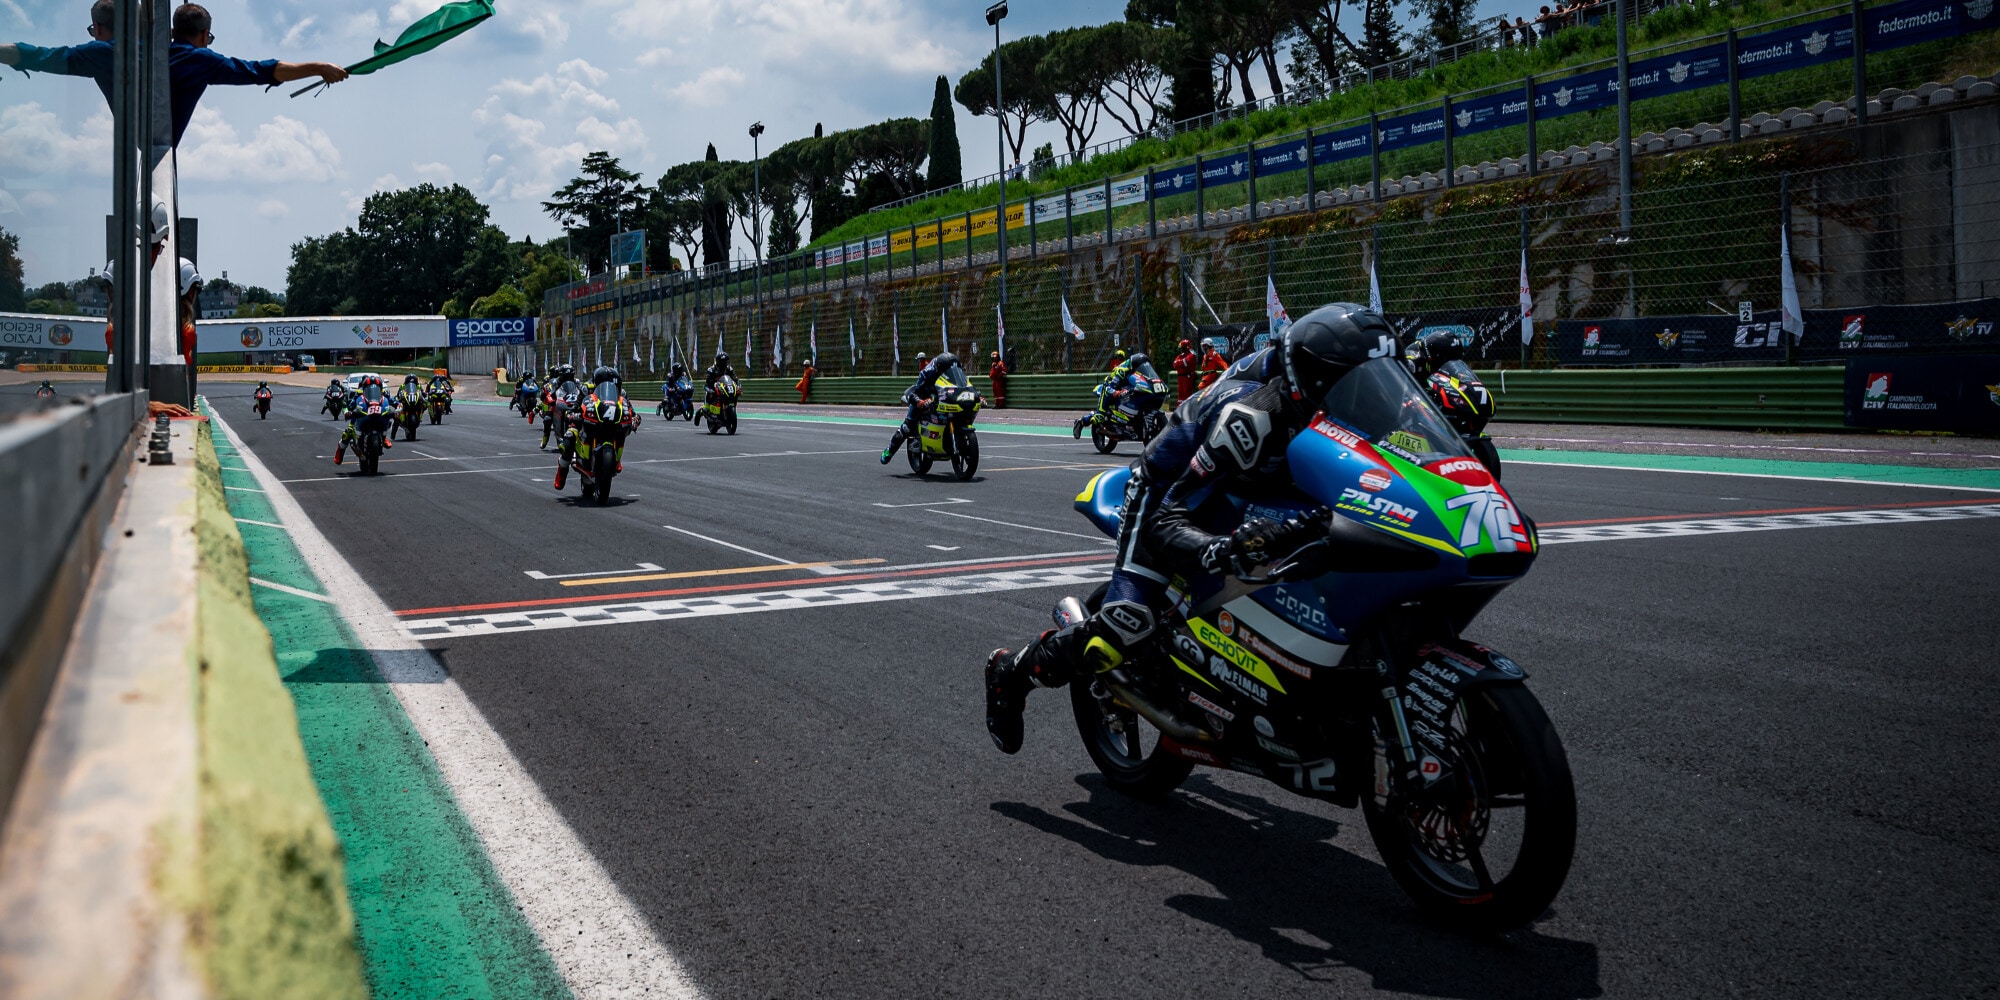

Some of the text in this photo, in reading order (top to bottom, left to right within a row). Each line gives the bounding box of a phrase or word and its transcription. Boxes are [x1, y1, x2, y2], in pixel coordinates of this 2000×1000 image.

[1878, 5, 1953, 34] federmoto.it
[1331, 135, 1367, 151] federmoto.it
[1742, 311, 1750, 320] 2
[269, 325, 320, 336] REGIONE
[456, 320, 525, 338] sparco
[1976, 322, 1993, 335] TV
[269, 337, 304, 347] LAZIO
[566, 394, 578, 402] 23
[1473, 386, 1488, 405] 7
[1888, 395, 1924, 404] CAMPIONATO
[367, 405, 383, 415] 69
[1863, 401, 1886, 410] CIV
[1886, 402, 1937, 411] ITALIANOVELOCITÀ
[602, 406, 617, 421] 4
[1314, 421, 1361, 449] MOTUL
[1338, 487, 1419, 524] PASINI
[1335, 502, 1411, 528] RACING TEAM
[1446, 491, 1527, 550] 72
[1199, 626, 1259, 673] ECHOVIT
[1231, 671, 1270, 702] FIMAR
[1180, 747, 1215, 762] MOTUL
[1276, 757, 1337, 792] 72
[1424, 762, 1439, 774] D
